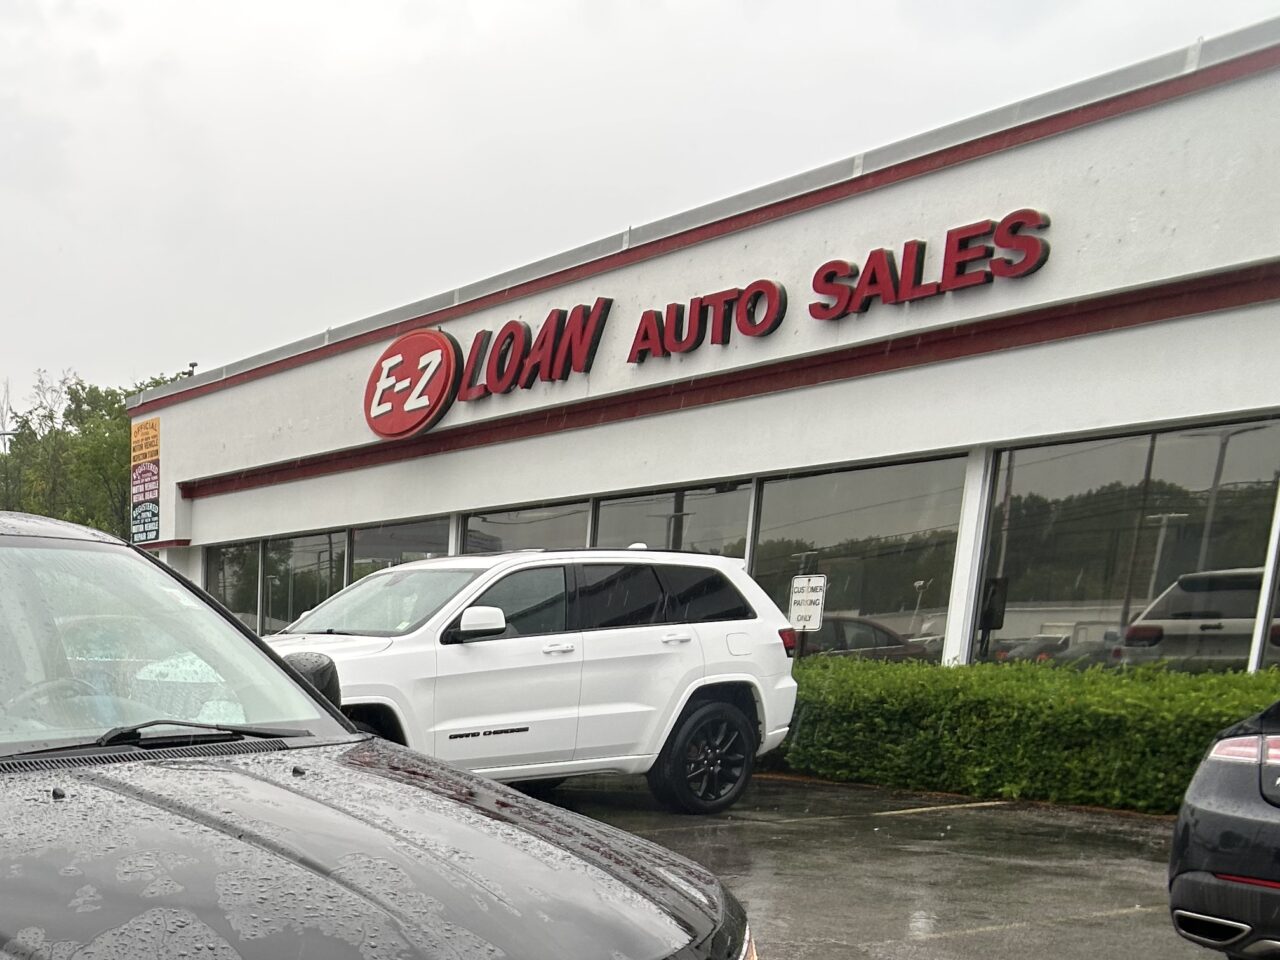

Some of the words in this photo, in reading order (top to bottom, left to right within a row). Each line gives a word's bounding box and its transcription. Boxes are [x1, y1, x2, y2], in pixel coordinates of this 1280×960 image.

[370, 349, 442, 418] E-Z
[458, 297, 613, 402] LOAN
[627, 279, 787, 364] AUTO
[809, 208, 1051, 322] SALES
[133, 421, 157, 438] OFFICIAL
[793, 599, 820, 607] PARKING
